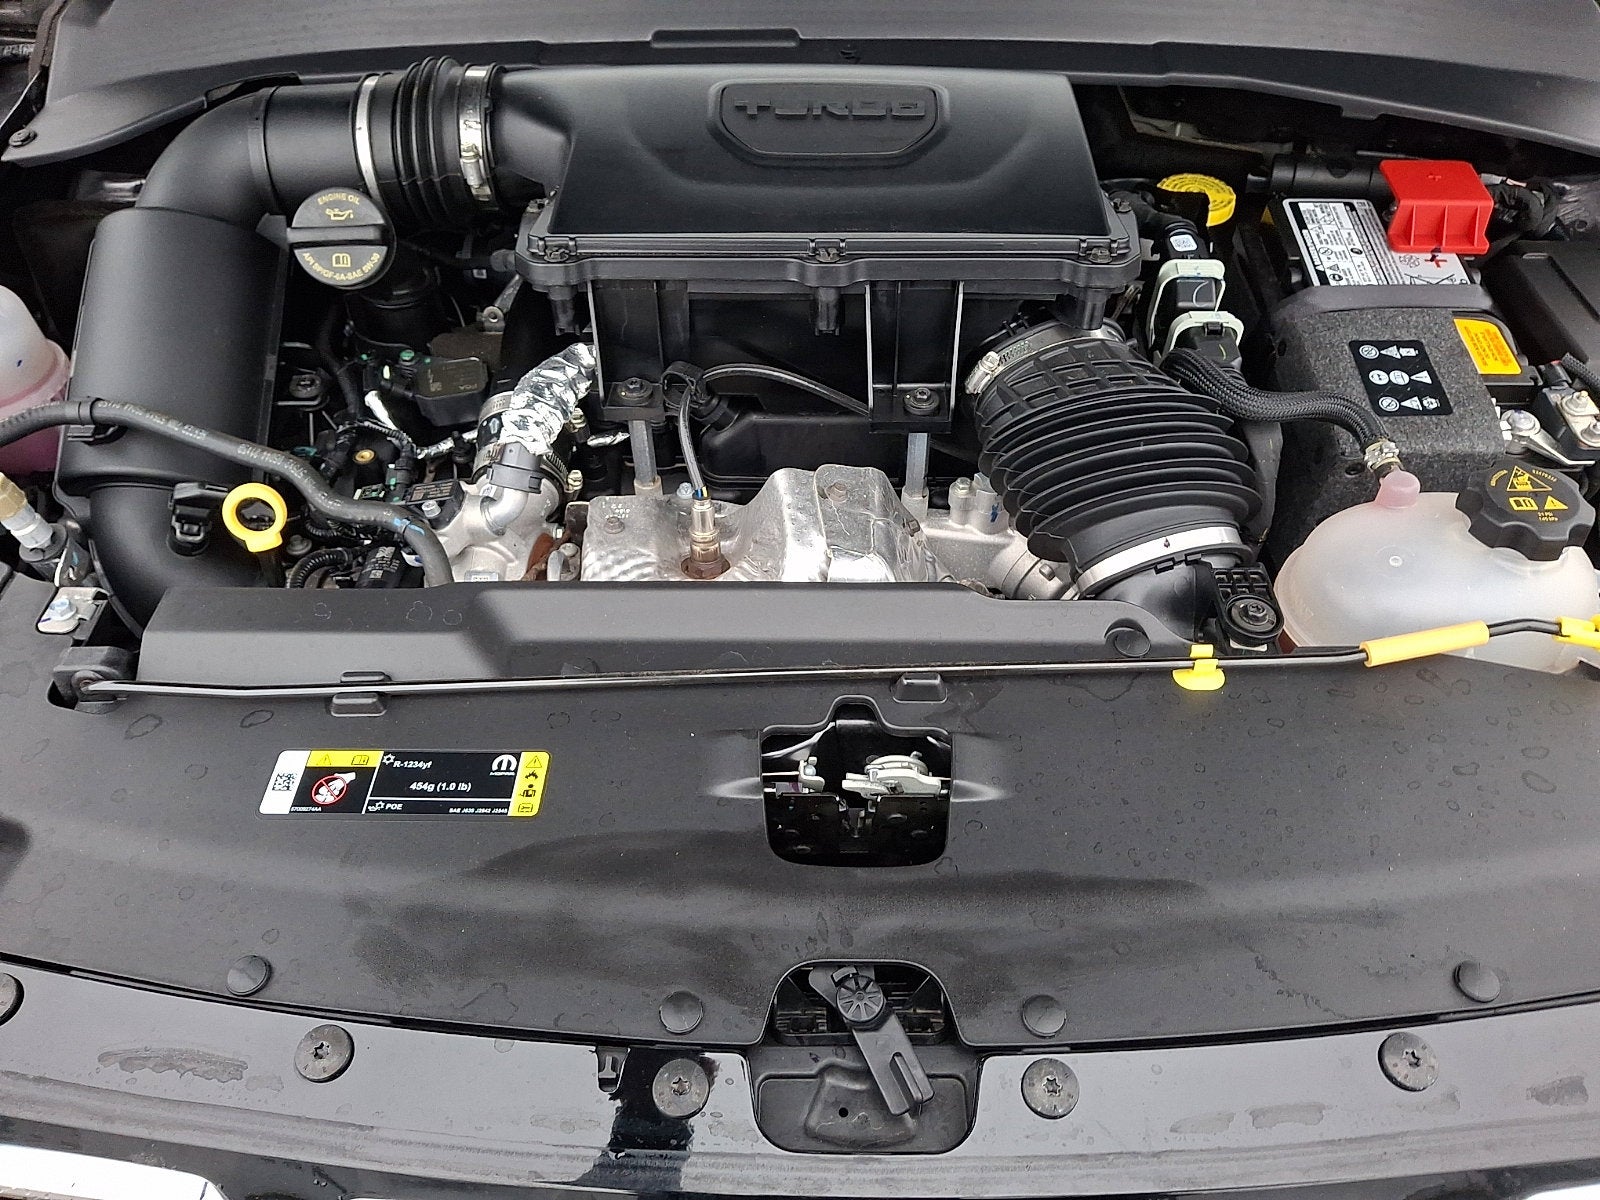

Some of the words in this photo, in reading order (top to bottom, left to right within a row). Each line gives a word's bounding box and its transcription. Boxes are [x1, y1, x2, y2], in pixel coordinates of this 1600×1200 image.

[734, 99, 926, 120] TURBO
[317, 192, 347, 205] ENGINE
[347, 194, 360, 206] OIL
[302, 252, 315, 266] API
[393, 760, 433, 770] R-1234yf
[409, 781, 436, 793] 454g
[436, 782, 457, 793] (1.0
[457, 782, 472, 793] lb)
[385, 803, 404, 811] POE
